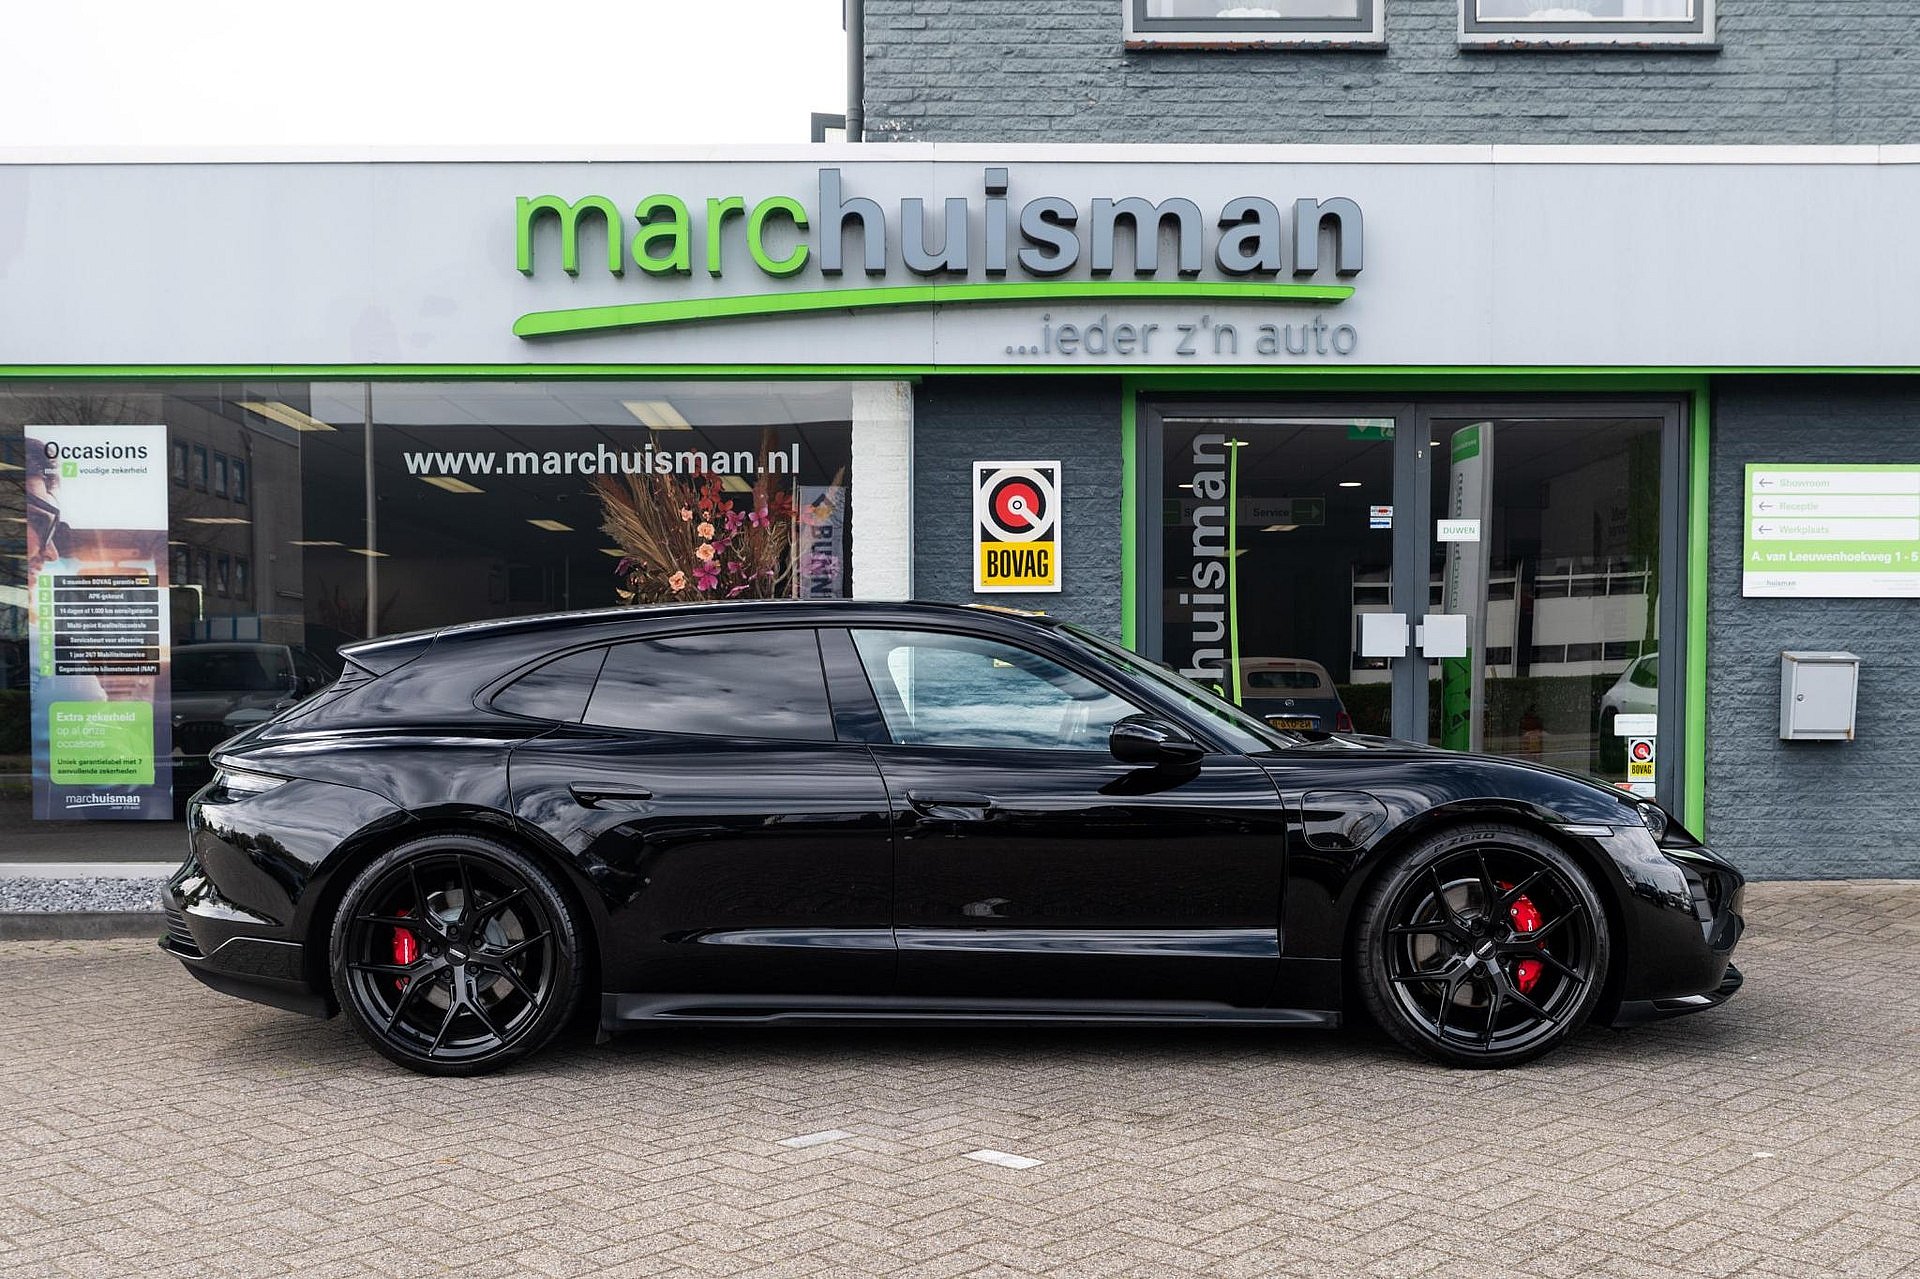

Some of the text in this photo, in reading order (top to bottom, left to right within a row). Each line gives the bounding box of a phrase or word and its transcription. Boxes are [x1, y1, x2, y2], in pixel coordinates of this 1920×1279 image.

[514, 167, 1365, 277] marchuisman
[1005, 313, 1358, 355] ...ieder z'n auto
[44, 441, 148, 459] Occasions
[403, 444, 800, 475] www.marchuisman.nl
[80, 466, 110, 475] voudige
[112, 466, 148, 474] zekerheid
[1779, 479, 1830, 488] Showroom
[1779, 501, 1819, 511] Receptie
[1253, 508, 1290, 518] Service
[1443, 527, 1475, 535] DUWEN
[1779, 525, 1830, 535] Werkplaats
[1751, 551, 1763, 561] A.
[1766, 553, 1786, 561] van
[1789, 551, 1892, 564] Leeuwenhoekweg
[1895, 551, 1901, 561] 1
[987, 549, 1049, 578] BOVAG
[56, 711, 136, 722] Extra zekerheid
[57, 726, 106, 736] op al onze
[57, 758, 76, 766] Uniek
[78, 758, 122, 767] garantielabel
[57, 767, 137, 775] aanvullende zekerheden
[1631, 764, 1652, 775] BOVAG
[65, 793, 140, 803] marchuisman
